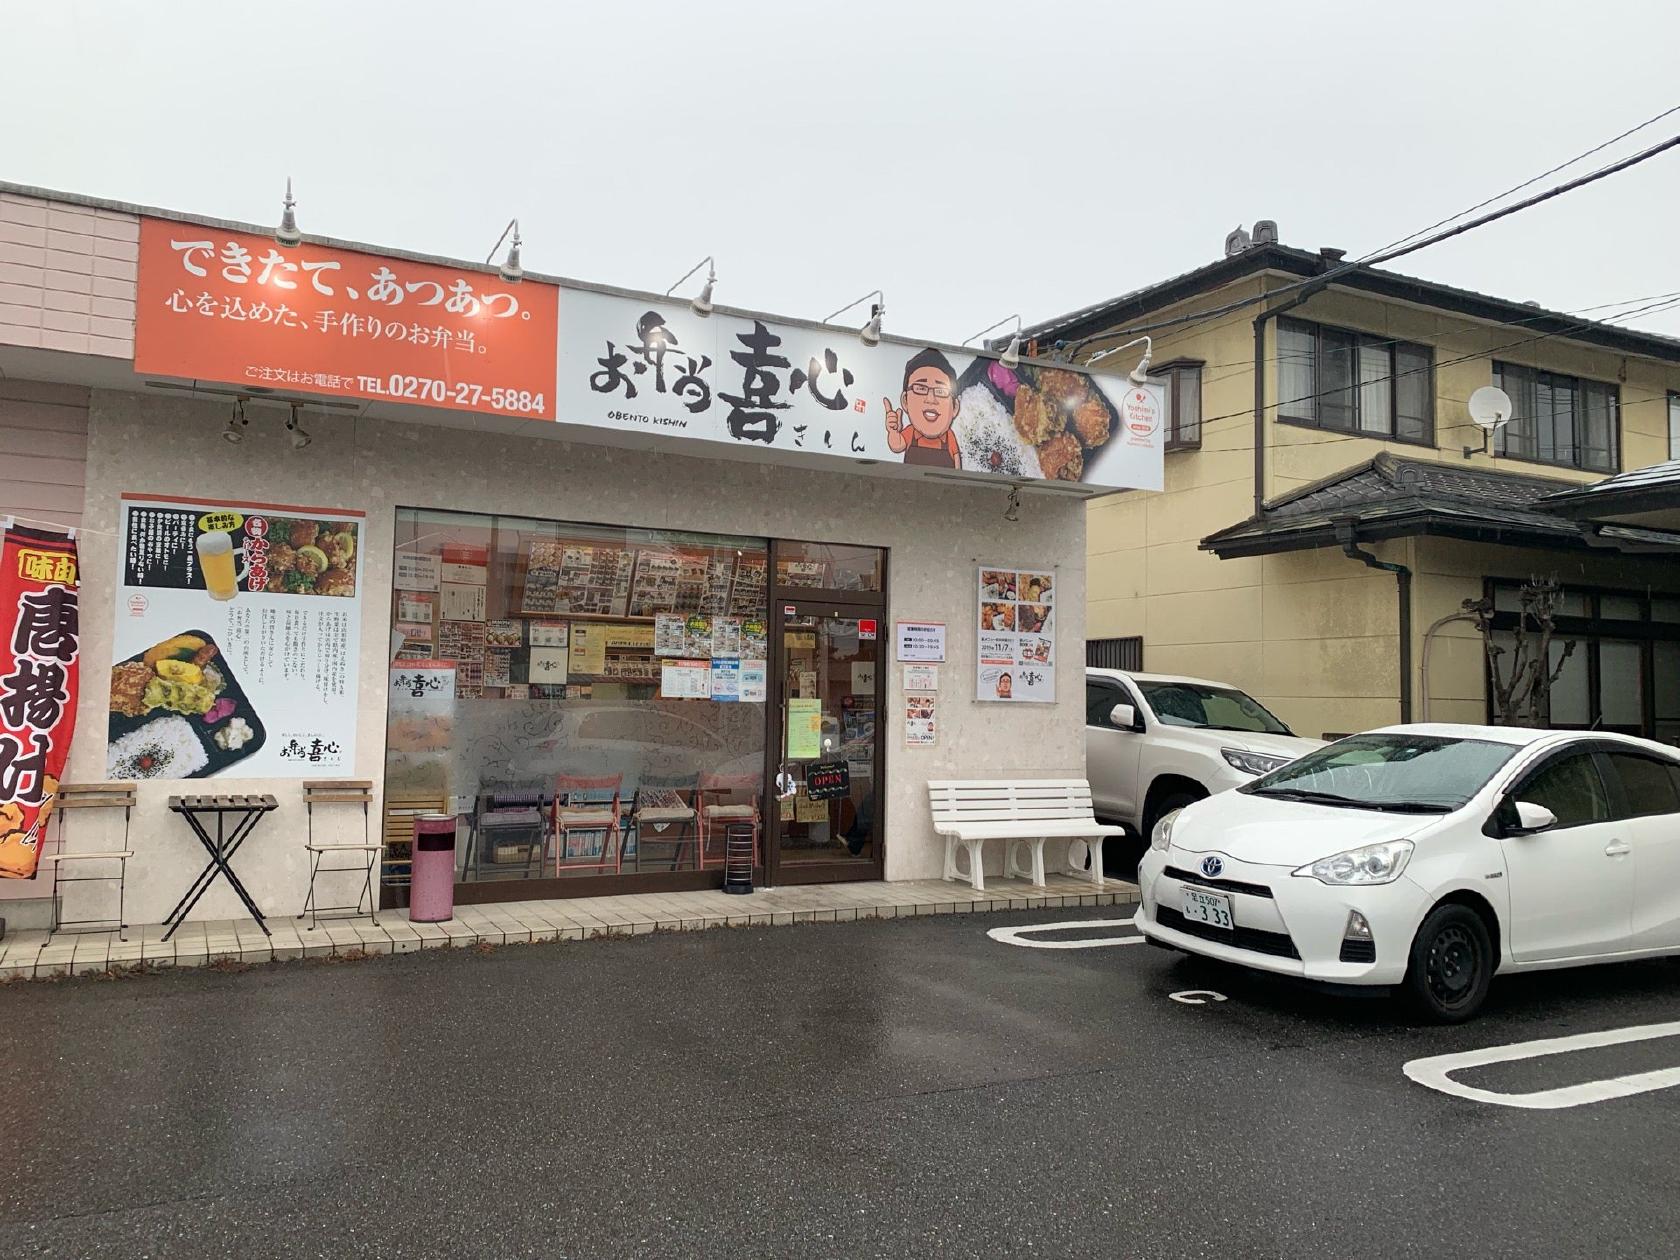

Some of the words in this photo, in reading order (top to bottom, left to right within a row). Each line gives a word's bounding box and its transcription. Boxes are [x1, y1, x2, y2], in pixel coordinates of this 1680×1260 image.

[170, 238, 531, 321] できたて、あつあつ。
[165, 287, 487, 355] 心を込めた、手作りのお弁当。
[245, 366, 354, 390] ご注文はお電話で
[607, 410, 649, 424] OBENTO
[652, 415, 688, 428] KISHIN
[248, 537, 270, 592] からあげ
[814, 773, 843, 786] OPEN
